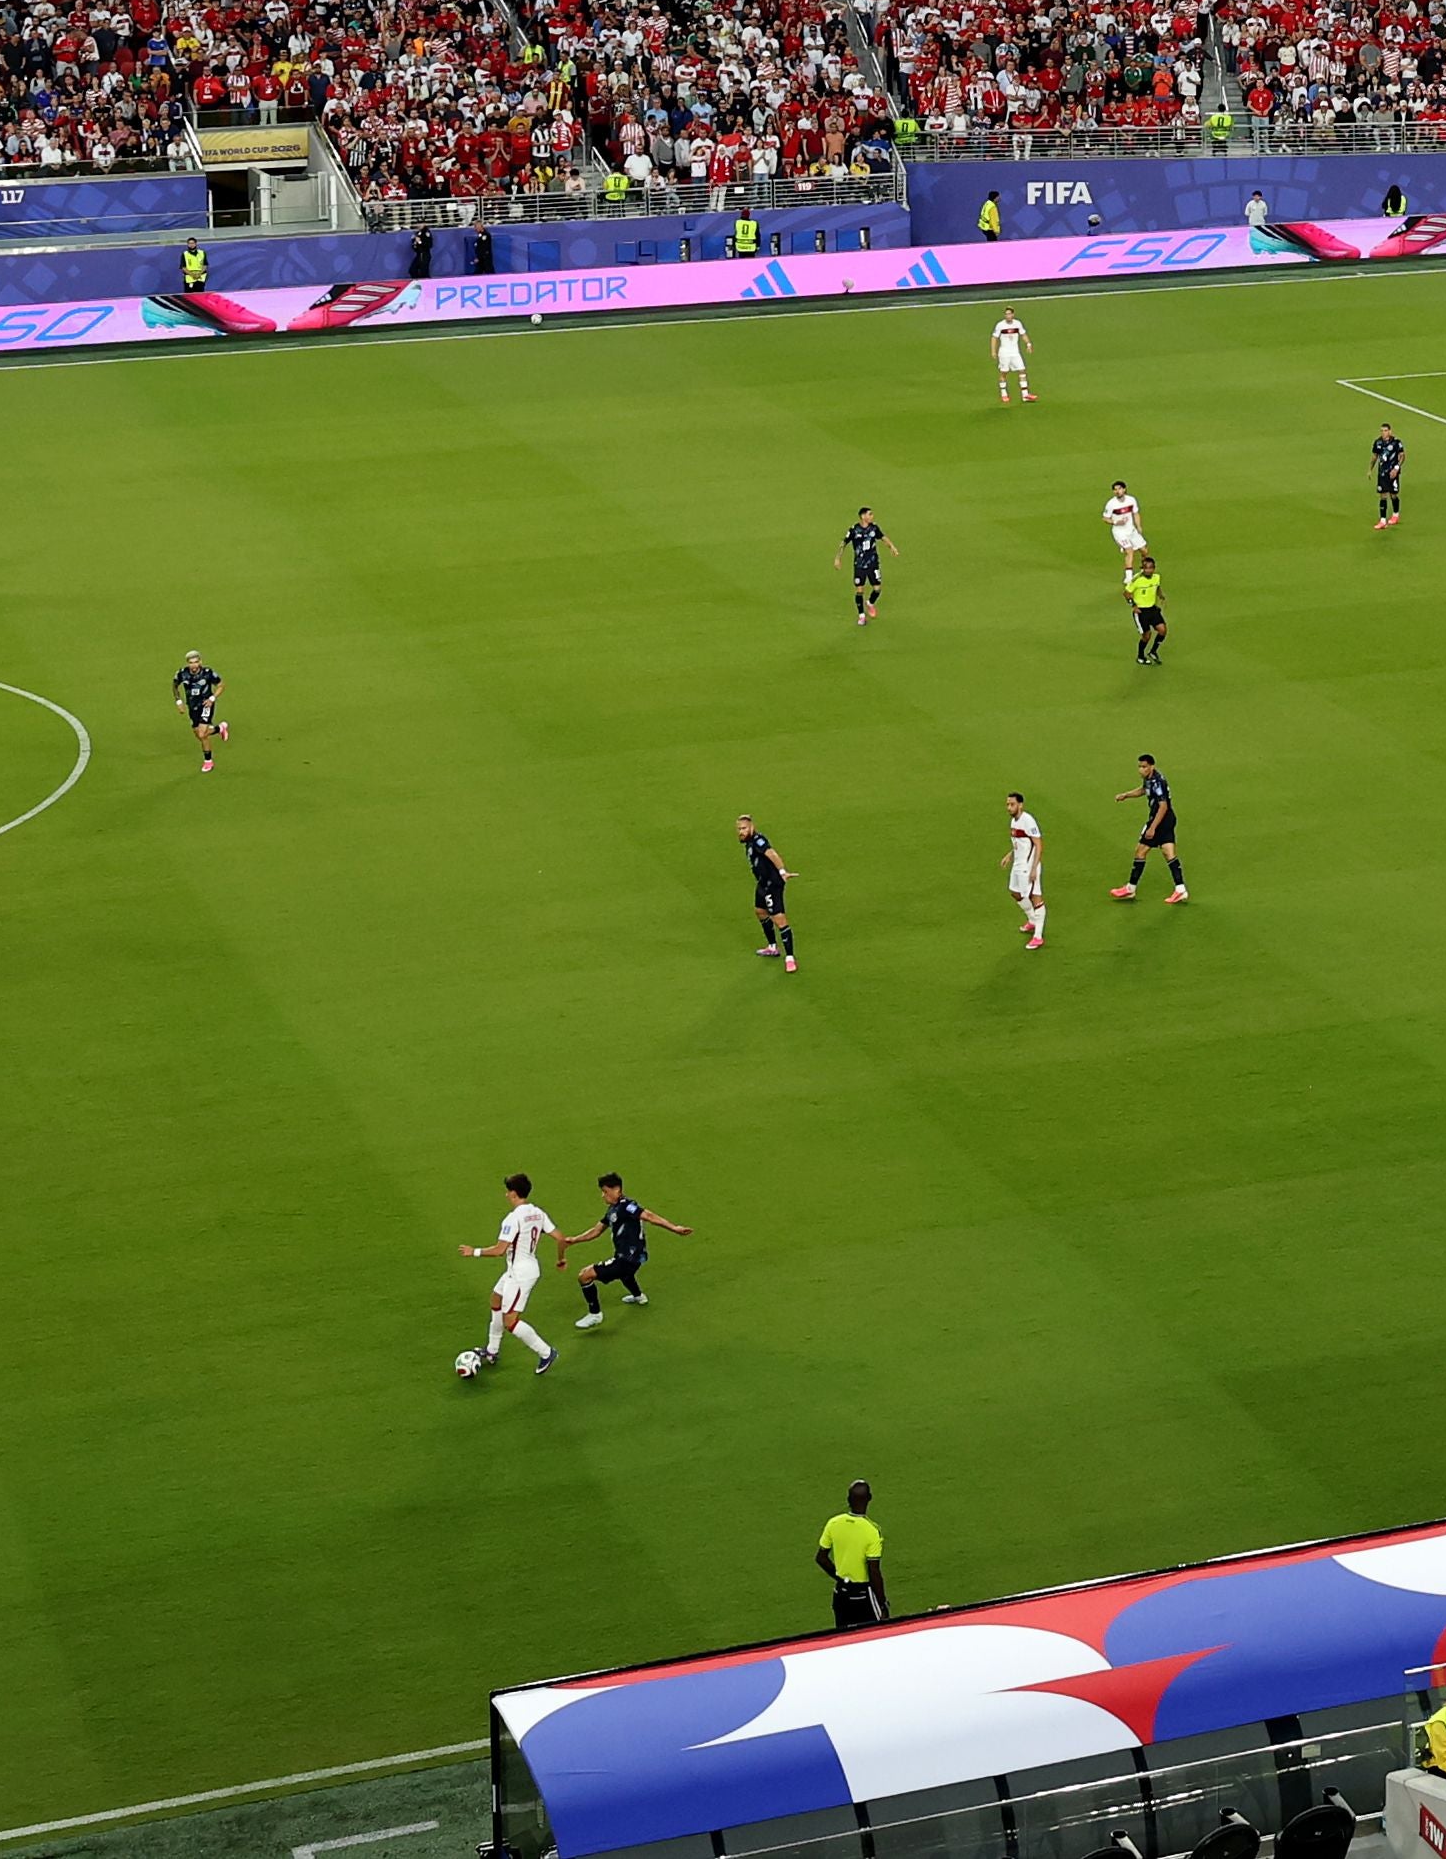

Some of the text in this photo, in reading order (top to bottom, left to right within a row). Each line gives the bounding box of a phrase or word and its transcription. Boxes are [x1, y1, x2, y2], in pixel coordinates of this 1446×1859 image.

[220, 147, 251, 156] WORLD
[252, 146, 269, 154] CUP
[271, 144, 300, 153] 2026
[0, 190, 25, 205] 117
[798, 183, 812, 191] 119
[1028, 182, 1092, 205] FIFA
[1060, 234, 1226, 271] F50
[435, 277, 627, 308] PREDATOR
[530, 1226, 539, 1253] 8
